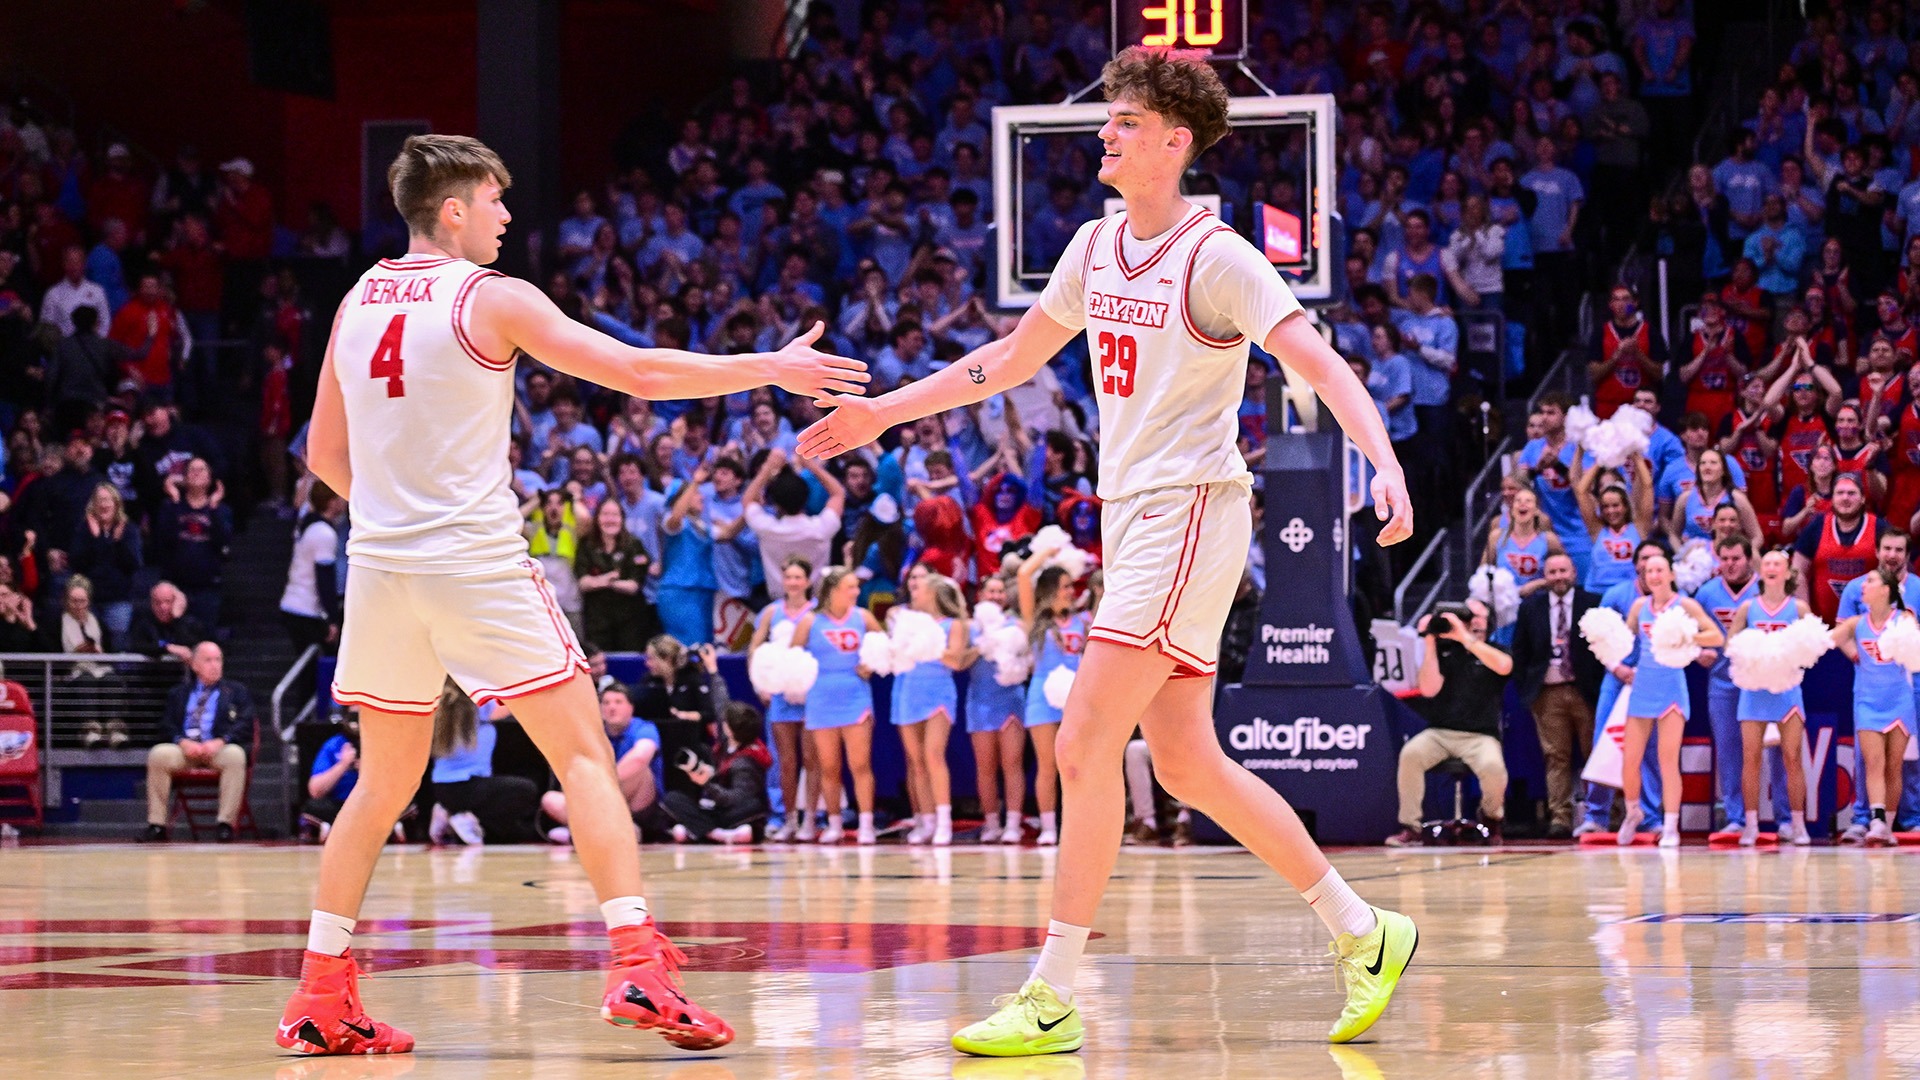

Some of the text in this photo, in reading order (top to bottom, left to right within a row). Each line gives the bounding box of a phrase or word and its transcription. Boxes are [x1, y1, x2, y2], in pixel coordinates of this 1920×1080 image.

[1141, 0, 1222, 46] 30
[361, 276, 440, 305] DERKACK
[1089, 291, 1169, 329] DAYTON
[370, 314, 406, 398] 4
[1098, 331, 1137, 398] 29
[968, 364, 987, 385] 29
[1261, 623, 1335, 643] Premier
[1266, 645, 1330, 664] Health
[1229, 716, 1372, 757] altafiber
[1243, 758, 1312, 772] connecting
